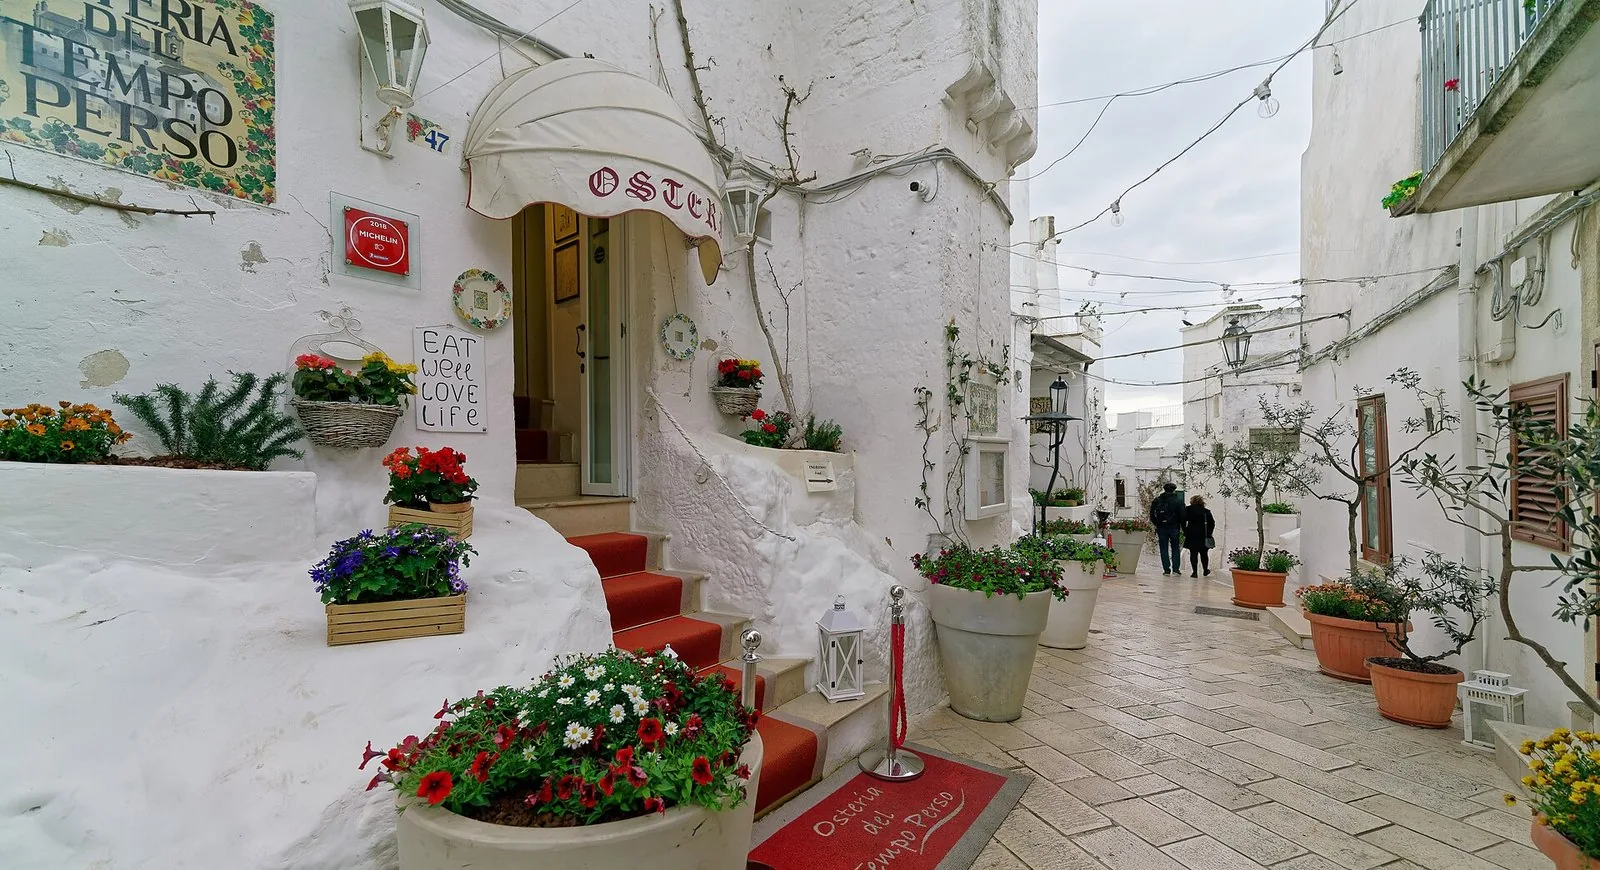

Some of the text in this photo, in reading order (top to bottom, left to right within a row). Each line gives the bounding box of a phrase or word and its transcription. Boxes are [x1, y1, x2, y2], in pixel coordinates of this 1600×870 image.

[83, 2, 181, 61] DEL
[100, 0, 239, 57] ERIA
[1, 16, 232, 126] TEMPO
[20, 71, 238, 168] PERSO
[425, 130, 449, 152] 47
[588, 166, 722, 238] OSTER
[359, 230, 398, 245] MICHELIN
[369, 220, 387, 230] 2018
[423, 330, 476, 358] EAT
[421, 382, 478, 404] LOVE
[1032, 401, 1051, 409] OSTE
[813, 786, 885, 837] Osteria
[853, 791, 954, 870] empo Perso
[861, 810, 895, 835] del
